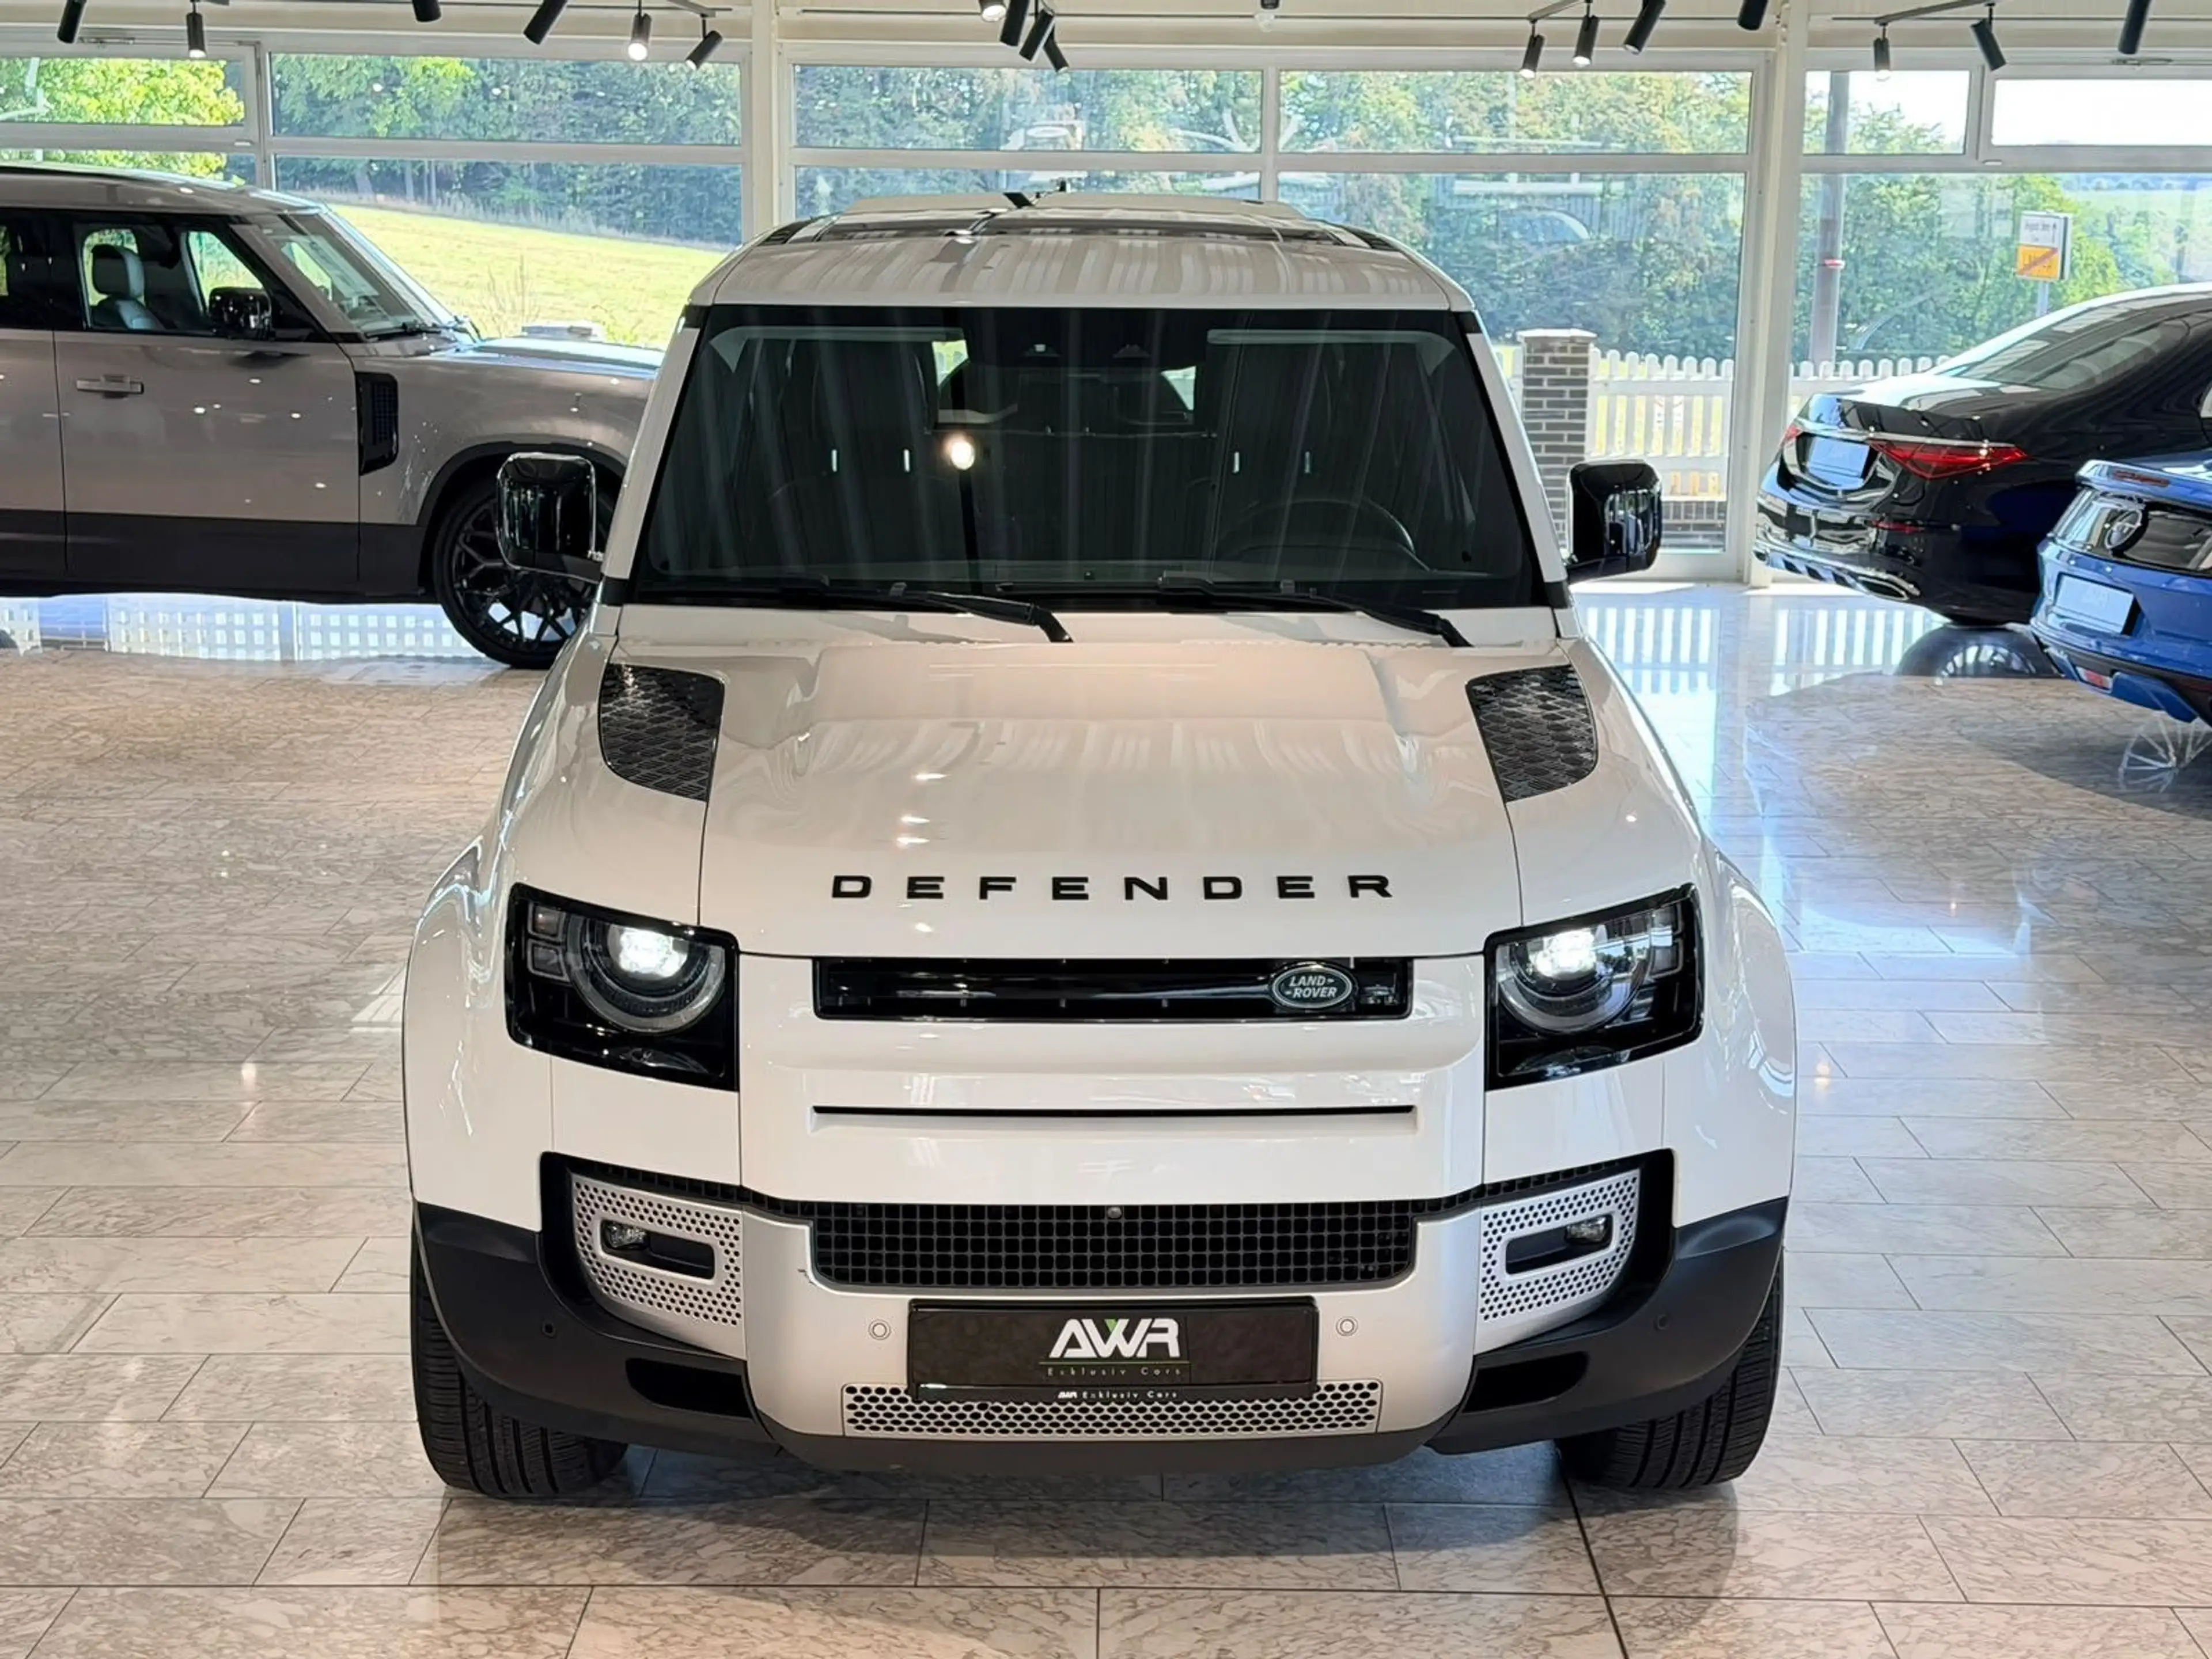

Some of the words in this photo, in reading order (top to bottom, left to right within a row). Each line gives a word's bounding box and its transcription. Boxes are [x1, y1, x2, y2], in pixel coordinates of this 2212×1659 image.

[832, 874, 1393, 900] DEFENDER
[1289, 975, 1325, 987] LAND
[1292, 987, 1337, 998] ROVER
[1048, 1318, 1180, 1358] AWR
